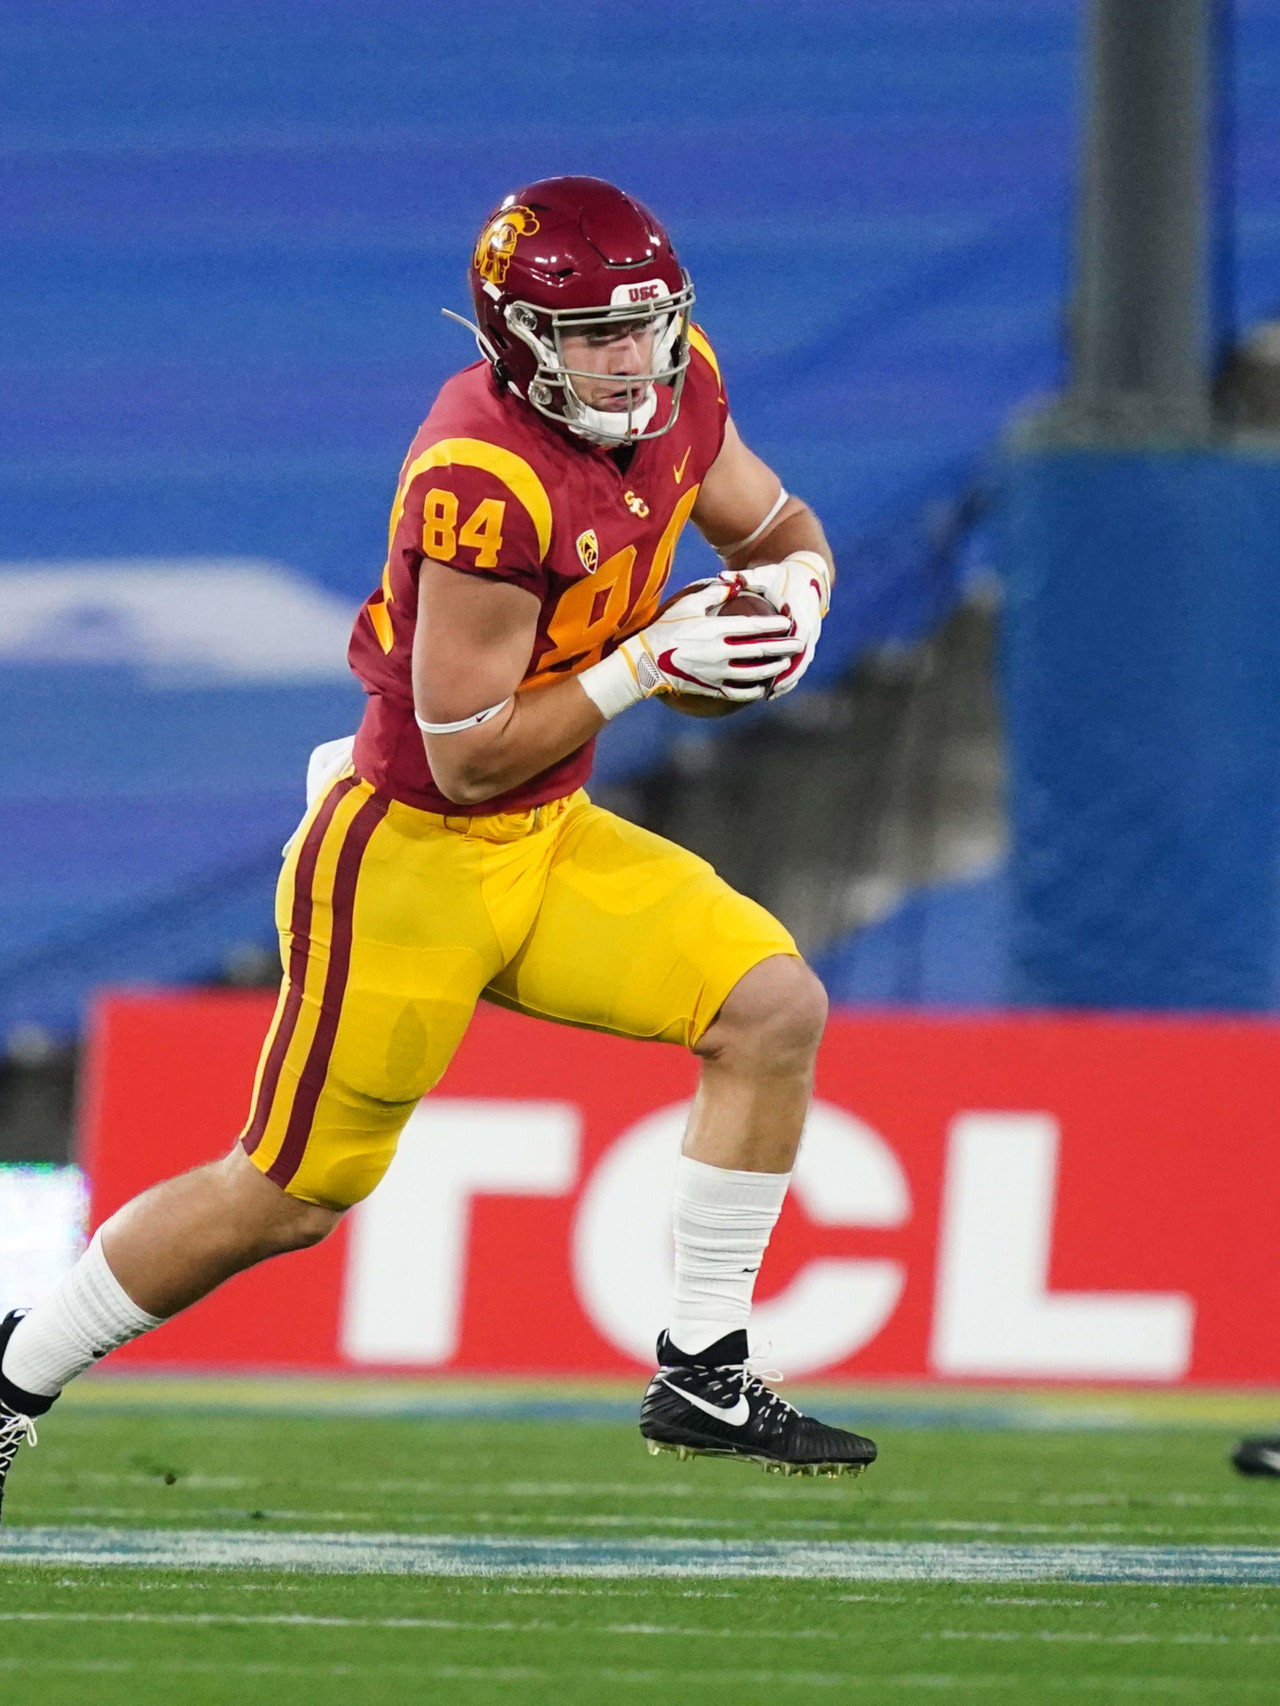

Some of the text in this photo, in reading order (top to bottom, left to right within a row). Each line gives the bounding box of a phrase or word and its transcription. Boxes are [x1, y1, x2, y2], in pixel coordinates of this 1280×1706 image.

[628, 285, 659, 302] USC
[422, 487, 507, 569] 84
[338, 1098, 1198, 1382] TCL
